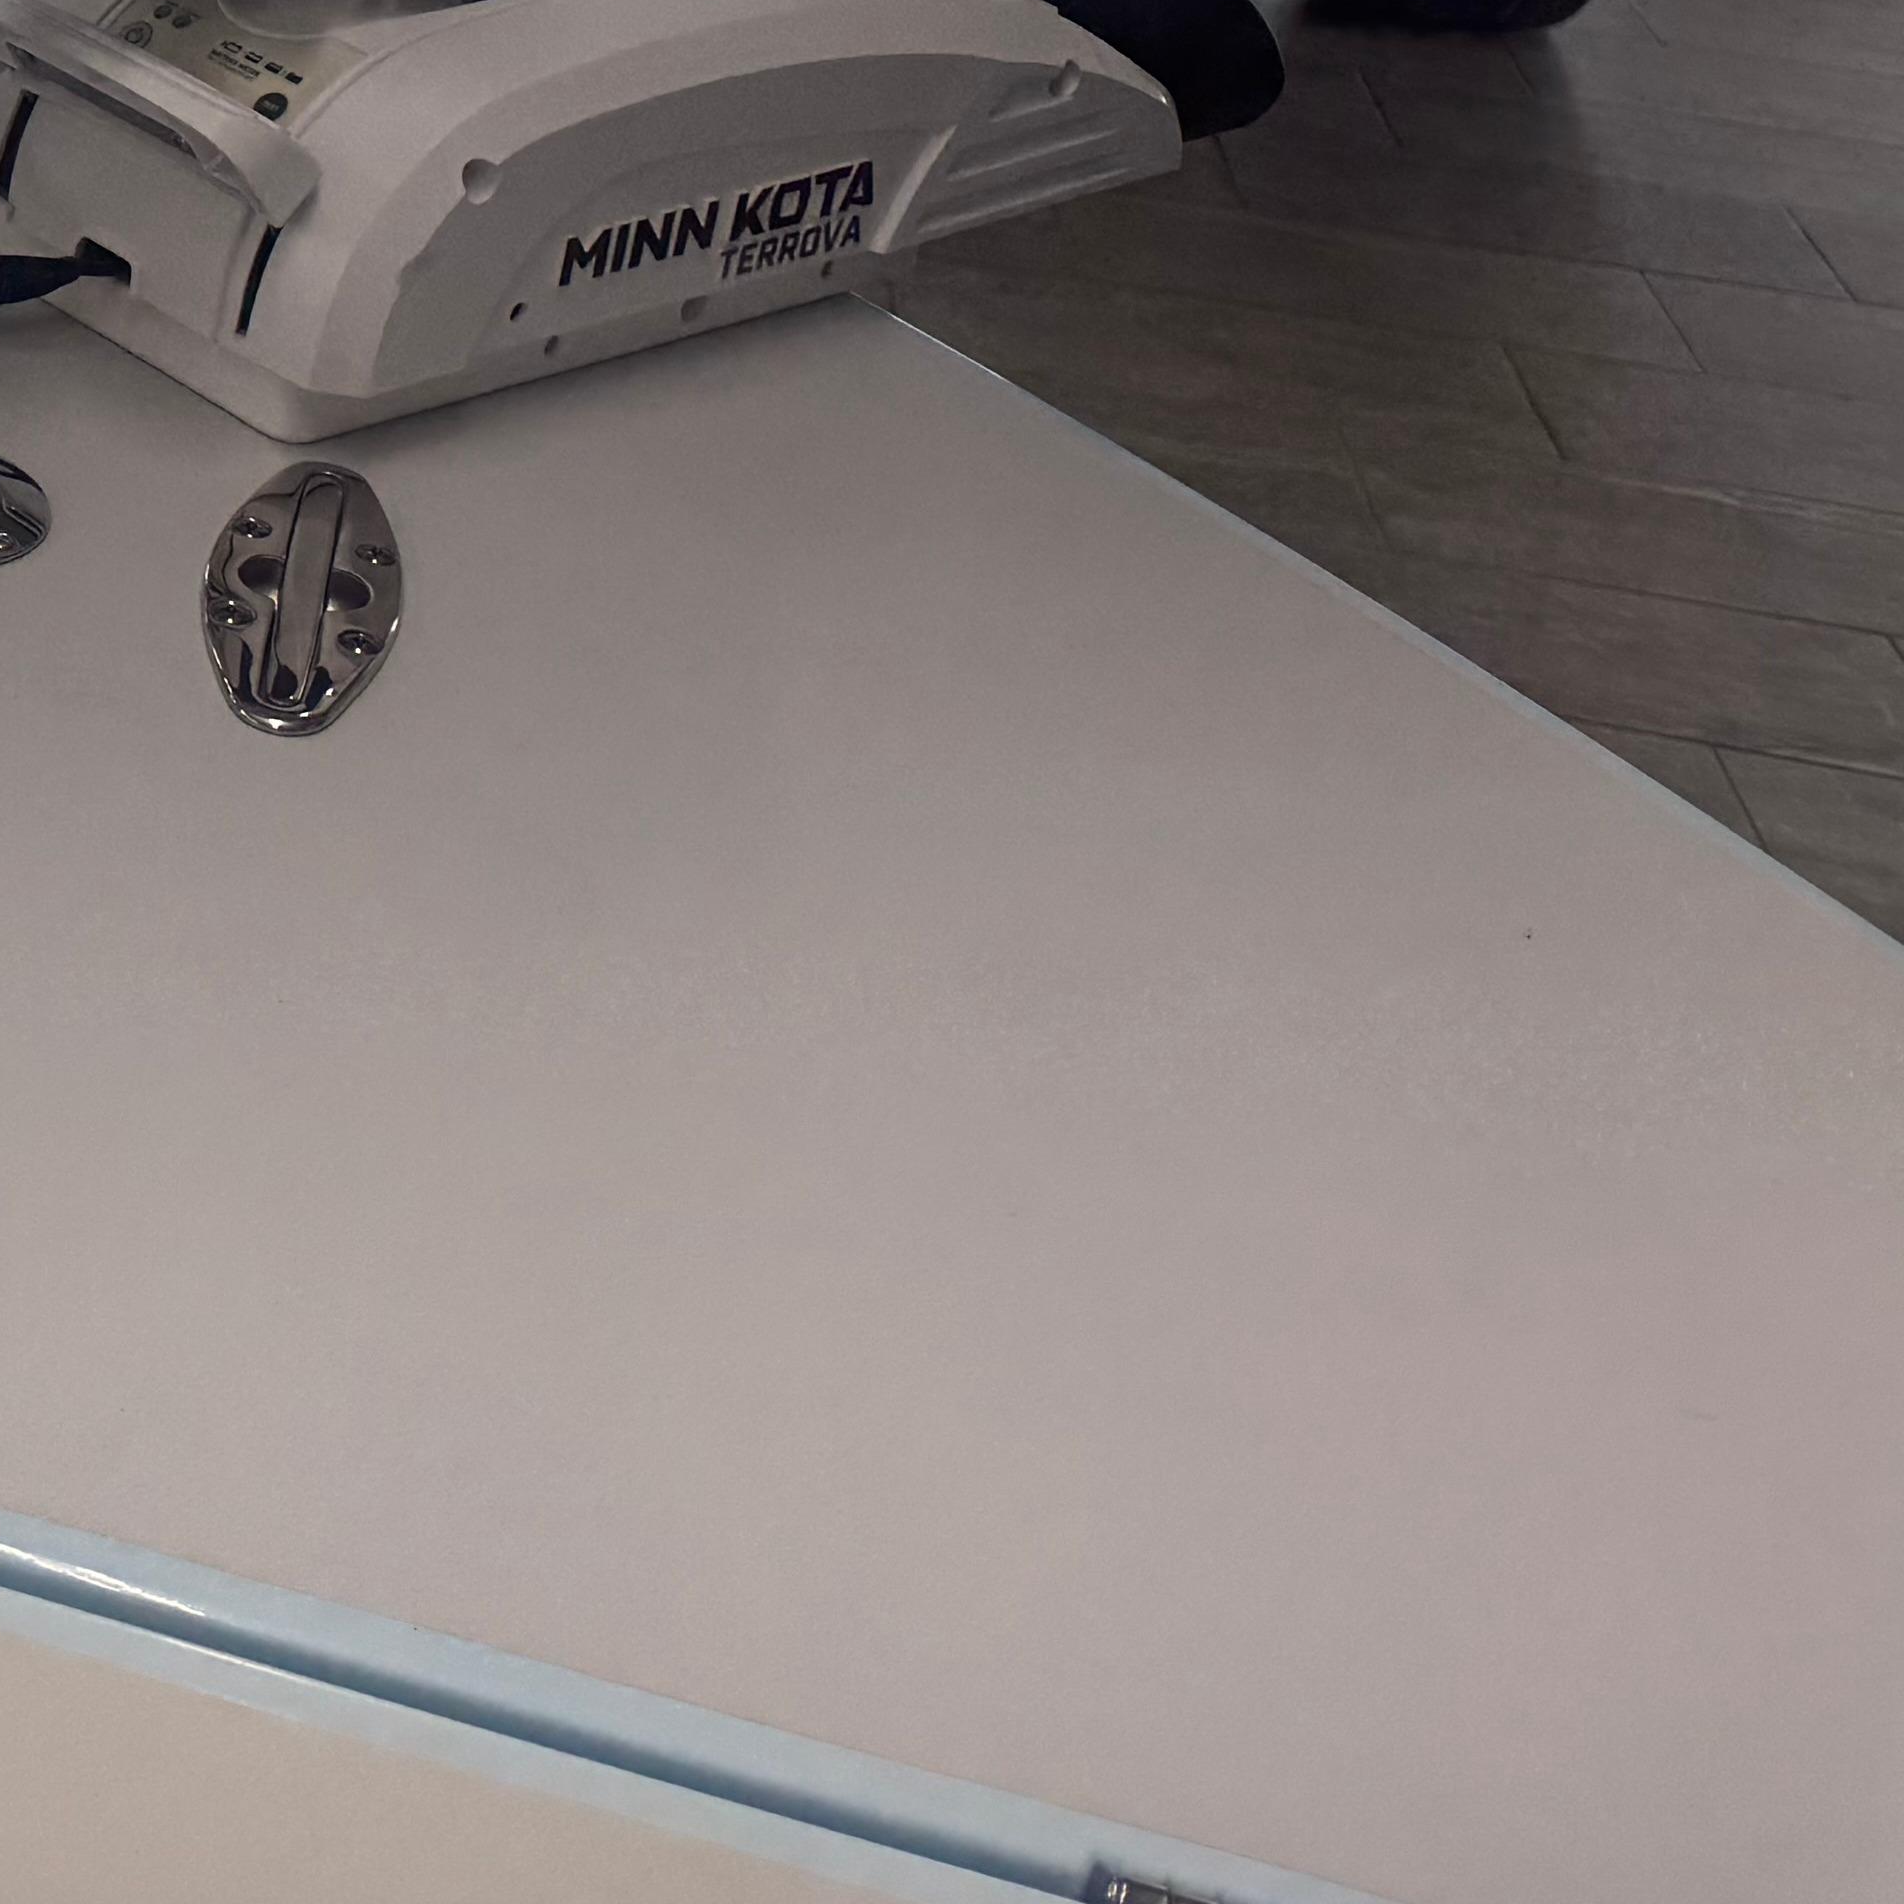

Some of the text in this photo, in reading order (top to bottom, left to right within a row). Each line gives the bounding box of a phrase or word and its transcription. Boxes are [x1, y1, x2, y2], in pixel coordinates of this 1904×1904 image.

[558, 159, 874, 287] MINN KOTA
[719, 214, 862, 280] TERROVA
